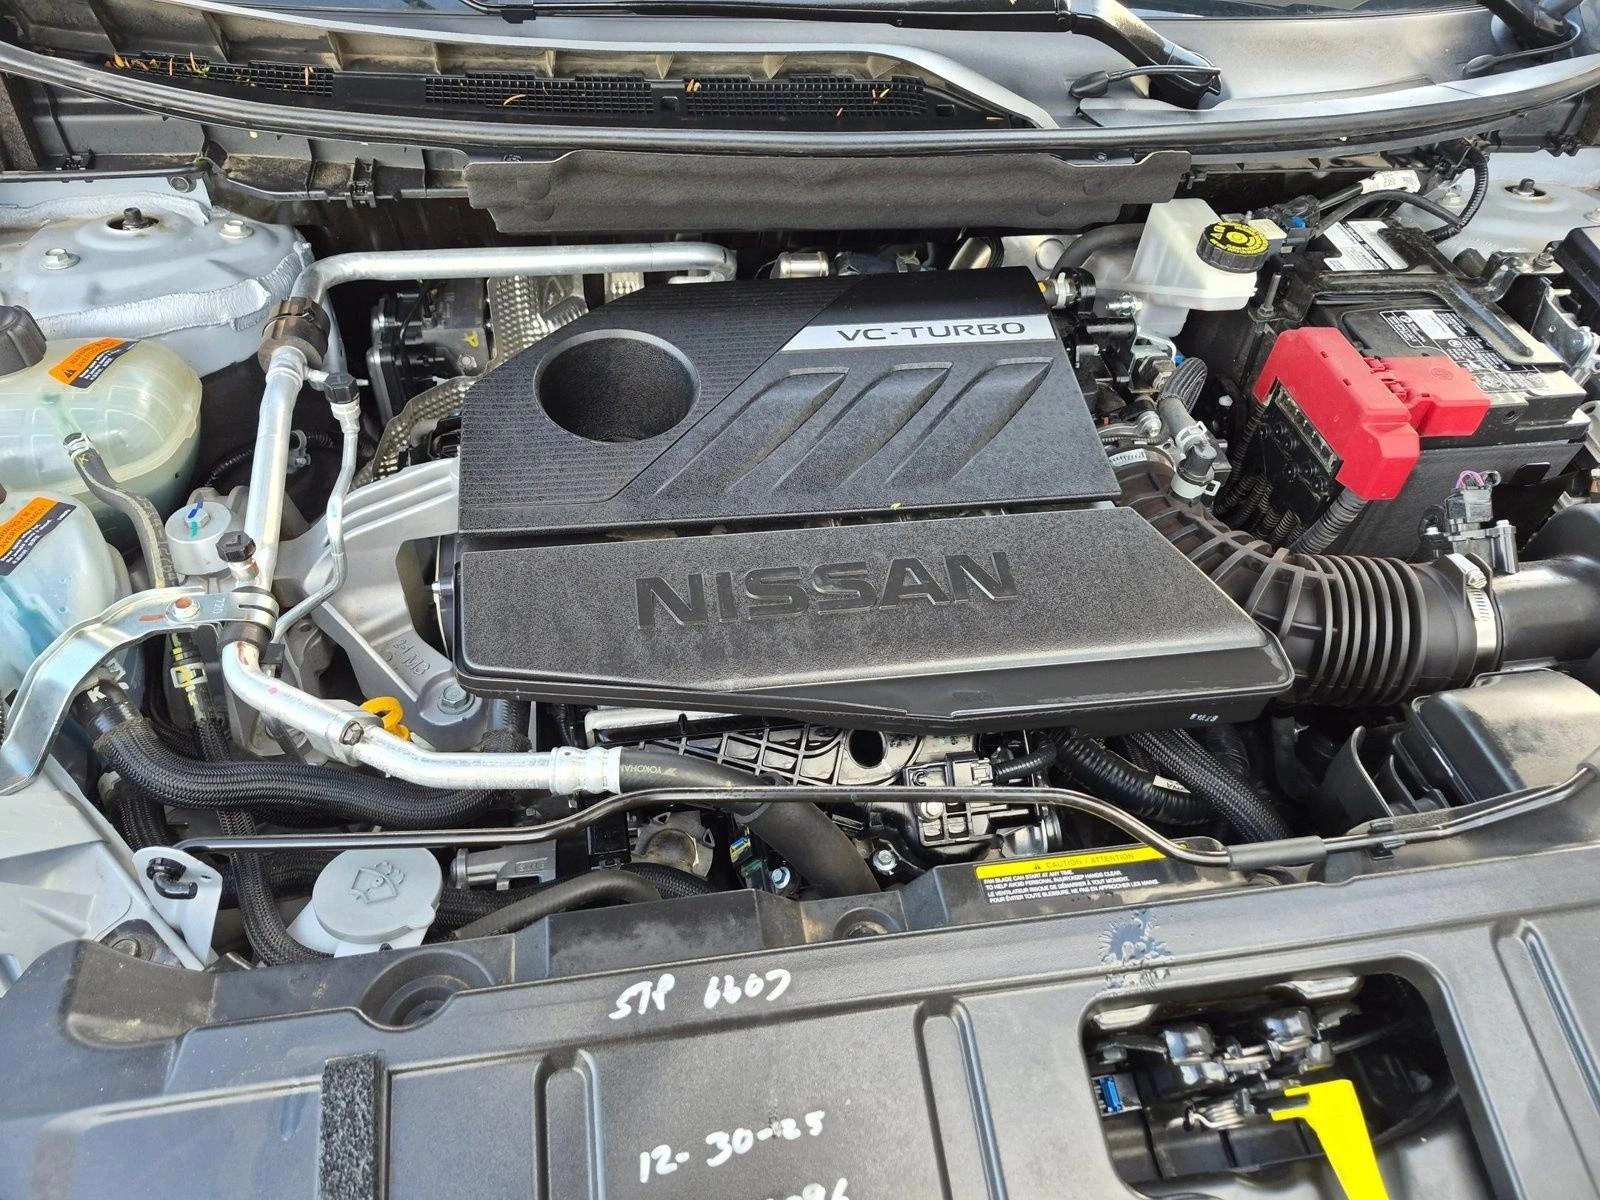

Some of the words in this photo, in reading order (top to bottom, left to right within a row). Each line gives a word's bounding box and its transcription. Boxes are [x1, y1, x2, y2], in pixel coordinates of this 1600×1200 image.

[837, 322, 1026, 341] VC-TURBO
[635, 552, 1018, 630] NISSAN
[621, 764, 662, 776] YOKOHA
[1046, 858, 1082, 869] CAUTION
[1090, 853, 1135, 864] ATTENTION
[995, 876, 1012, 884] BLADE
[1025, 878, 1052, 887] PERSONAL
[1085, 871, 1104, 879] HANDS
[1098, 881, 1131, 891] APPROCHER
[995, 887, 1029, 897] VENTILATEUR
[1029, 885, 1049, 893] RISQUE
